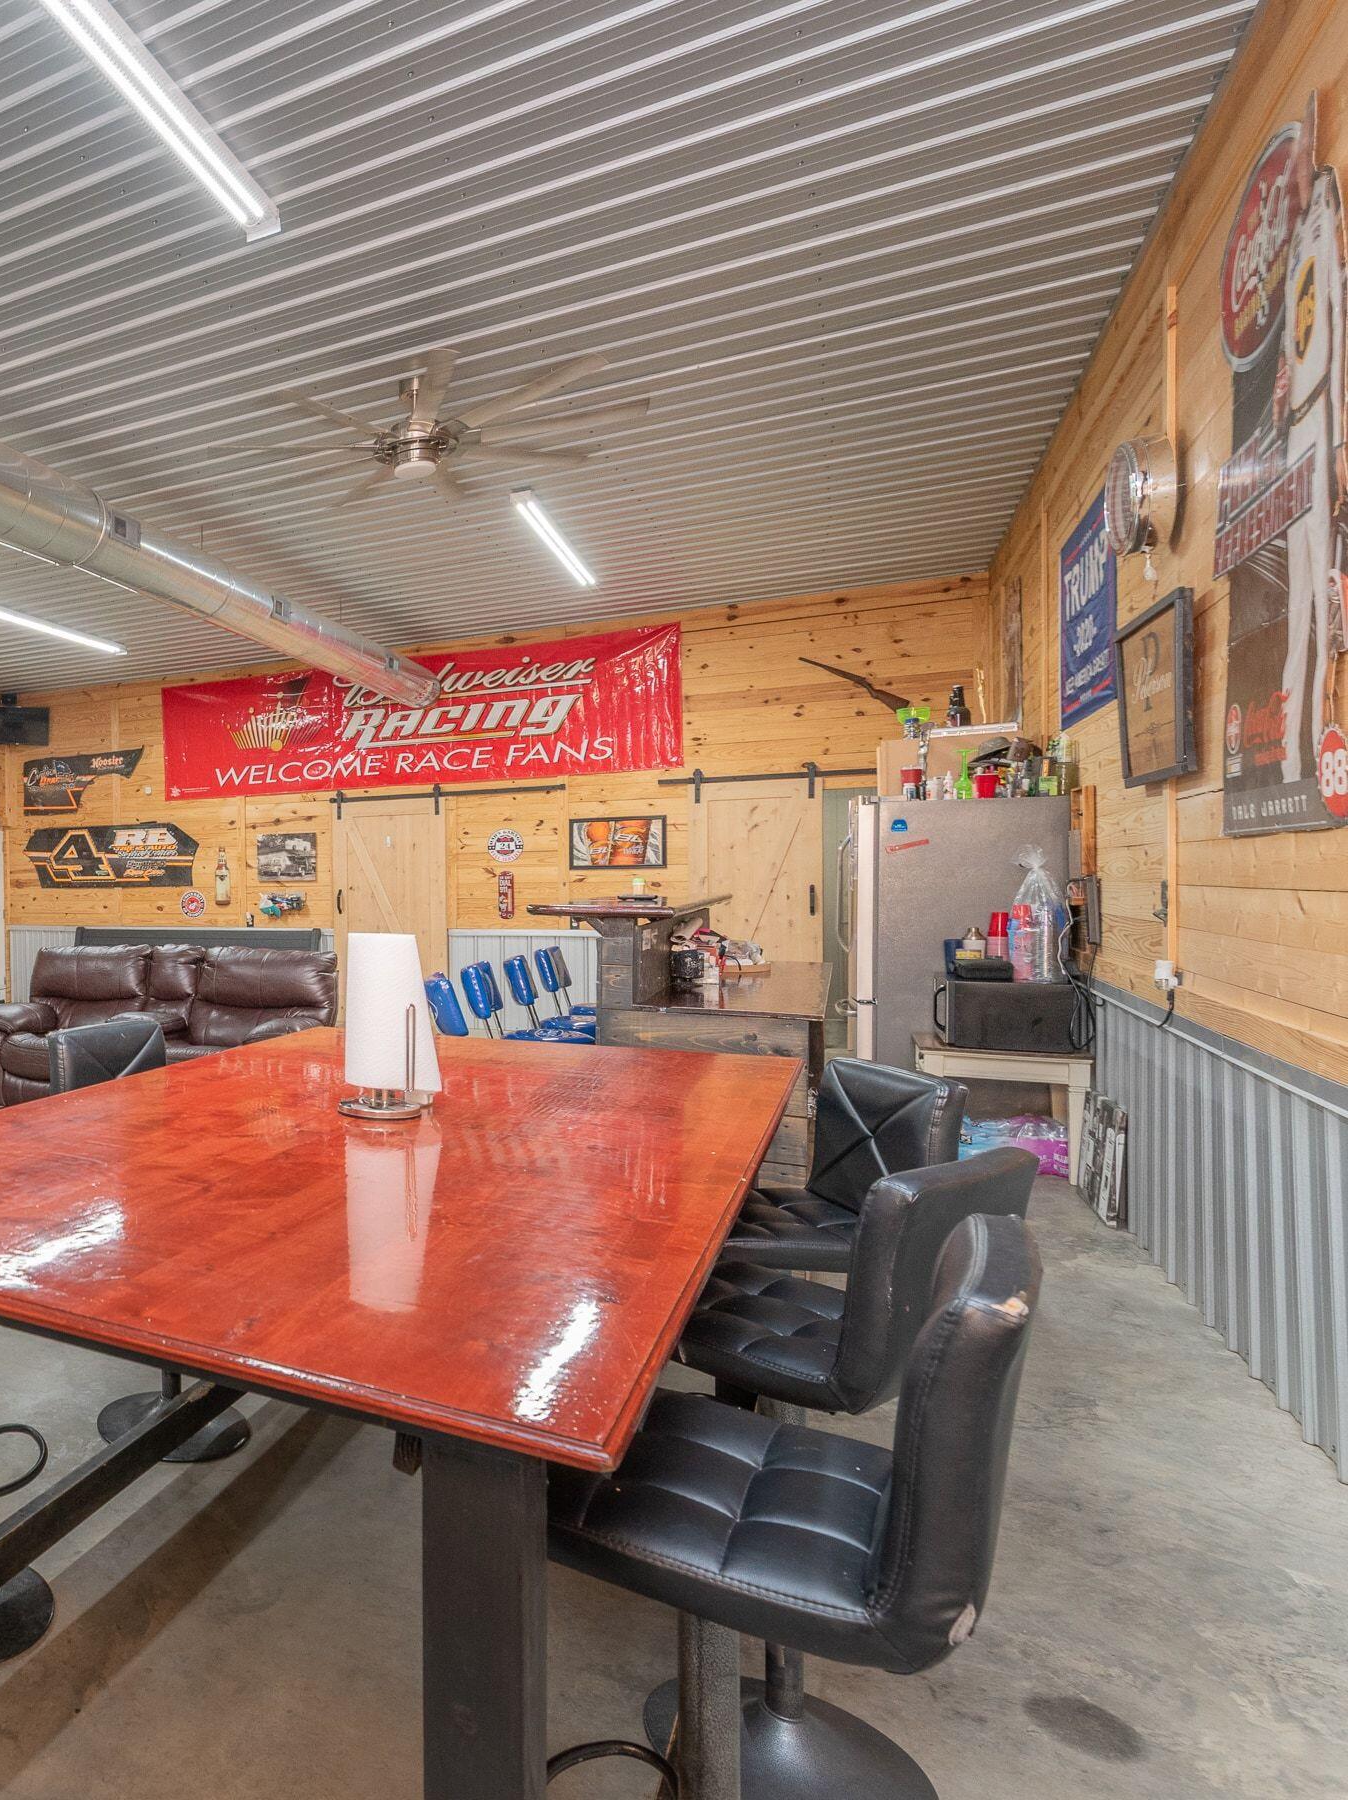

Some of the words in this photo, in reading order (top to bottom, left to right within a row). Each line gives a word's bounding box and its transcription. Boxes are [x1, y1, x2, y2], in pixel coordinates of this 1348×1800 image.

[1064, 529, 1108, 621] TRUMP
[214, 753, 382, 788] WELCOME
[395, 747, 492, 774] RACE
[506, 736, 614, 767] FANS
[1321, 748, 1348, 797] 88
[50, 829, 116, 881] 4
